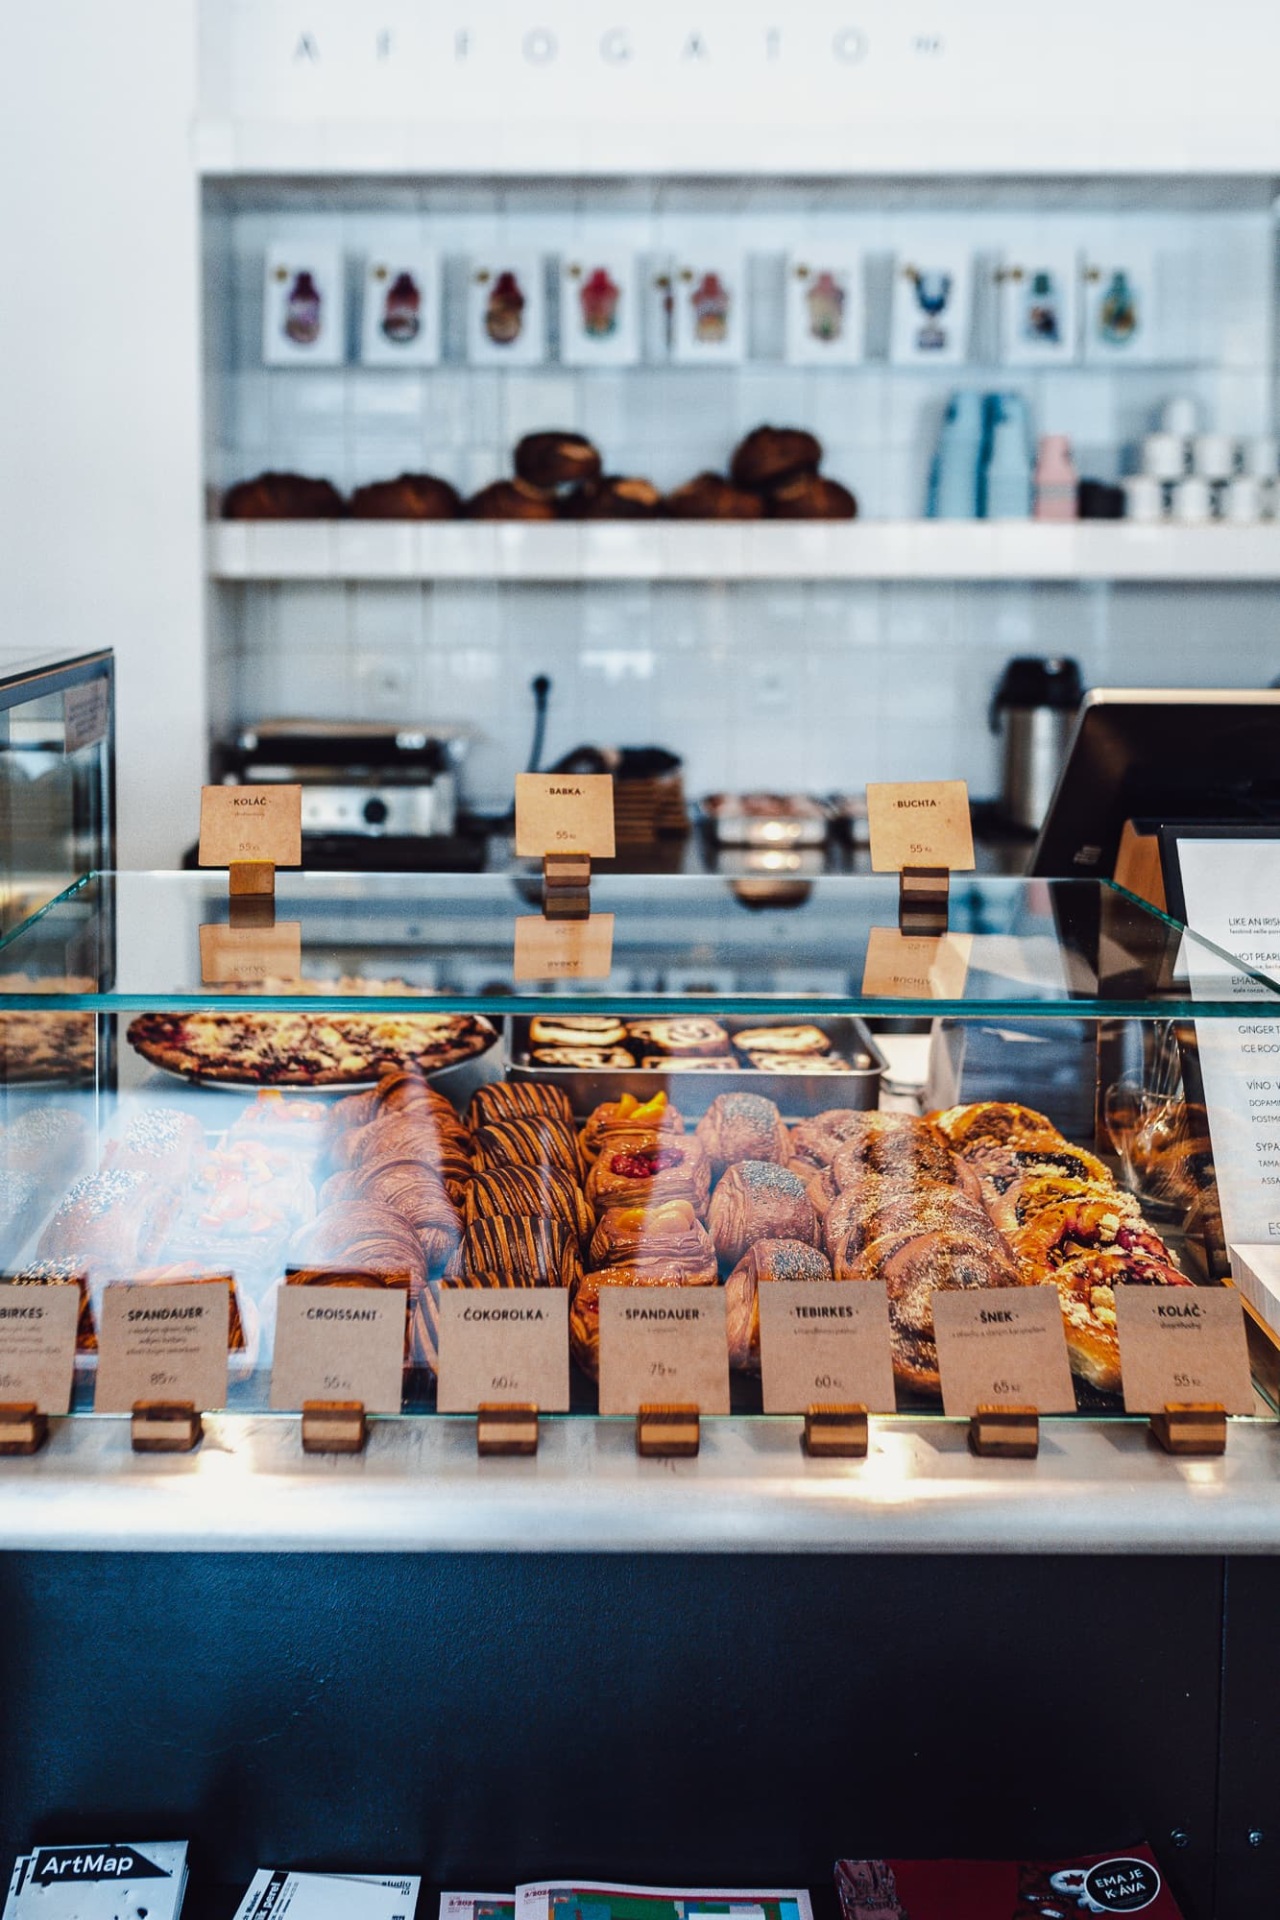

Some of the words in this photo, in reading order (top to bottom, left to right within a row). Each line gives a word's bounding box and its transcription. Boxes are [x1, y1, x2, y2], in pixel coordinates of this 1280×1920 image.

[549, 787, 581, 795] BABKA
[233, 796, 267, 806] KOLÁČ
[897, 799, 937, 808] BUCHTA
[910, 844, 923, 853] 55
[1238, 1025, 1274, 1034] GINGER
[1241, 1044, 1256, 1052] ICE
[1257, 1044, 1280, 1053] ROO
[127, 1306, 203, 1321] SPANDAUER
[306, 1307, 377, 1321] CROISSANT
[463, 1306, 543, 1321] ČOKOROLKA
[625, 1308, 699, 1320] SPANDAUER
[795, 1305, 853, 1319] TEBIRKES
[980, 1308, 1013, 1324] ŠNEK
[1157, 1303, 1201, 1317] KOLÁČ
[815, 1374, 831, 1389] 60
[993, 1380, 1009, 1394] 65
[1173, 1373, 1190, 1387] 55
[41, 1854, 134, 1876] ArtMap
[1095, 1874, 1127, 1889] EMA
[1129, 1868, 1144, 1881] JE
